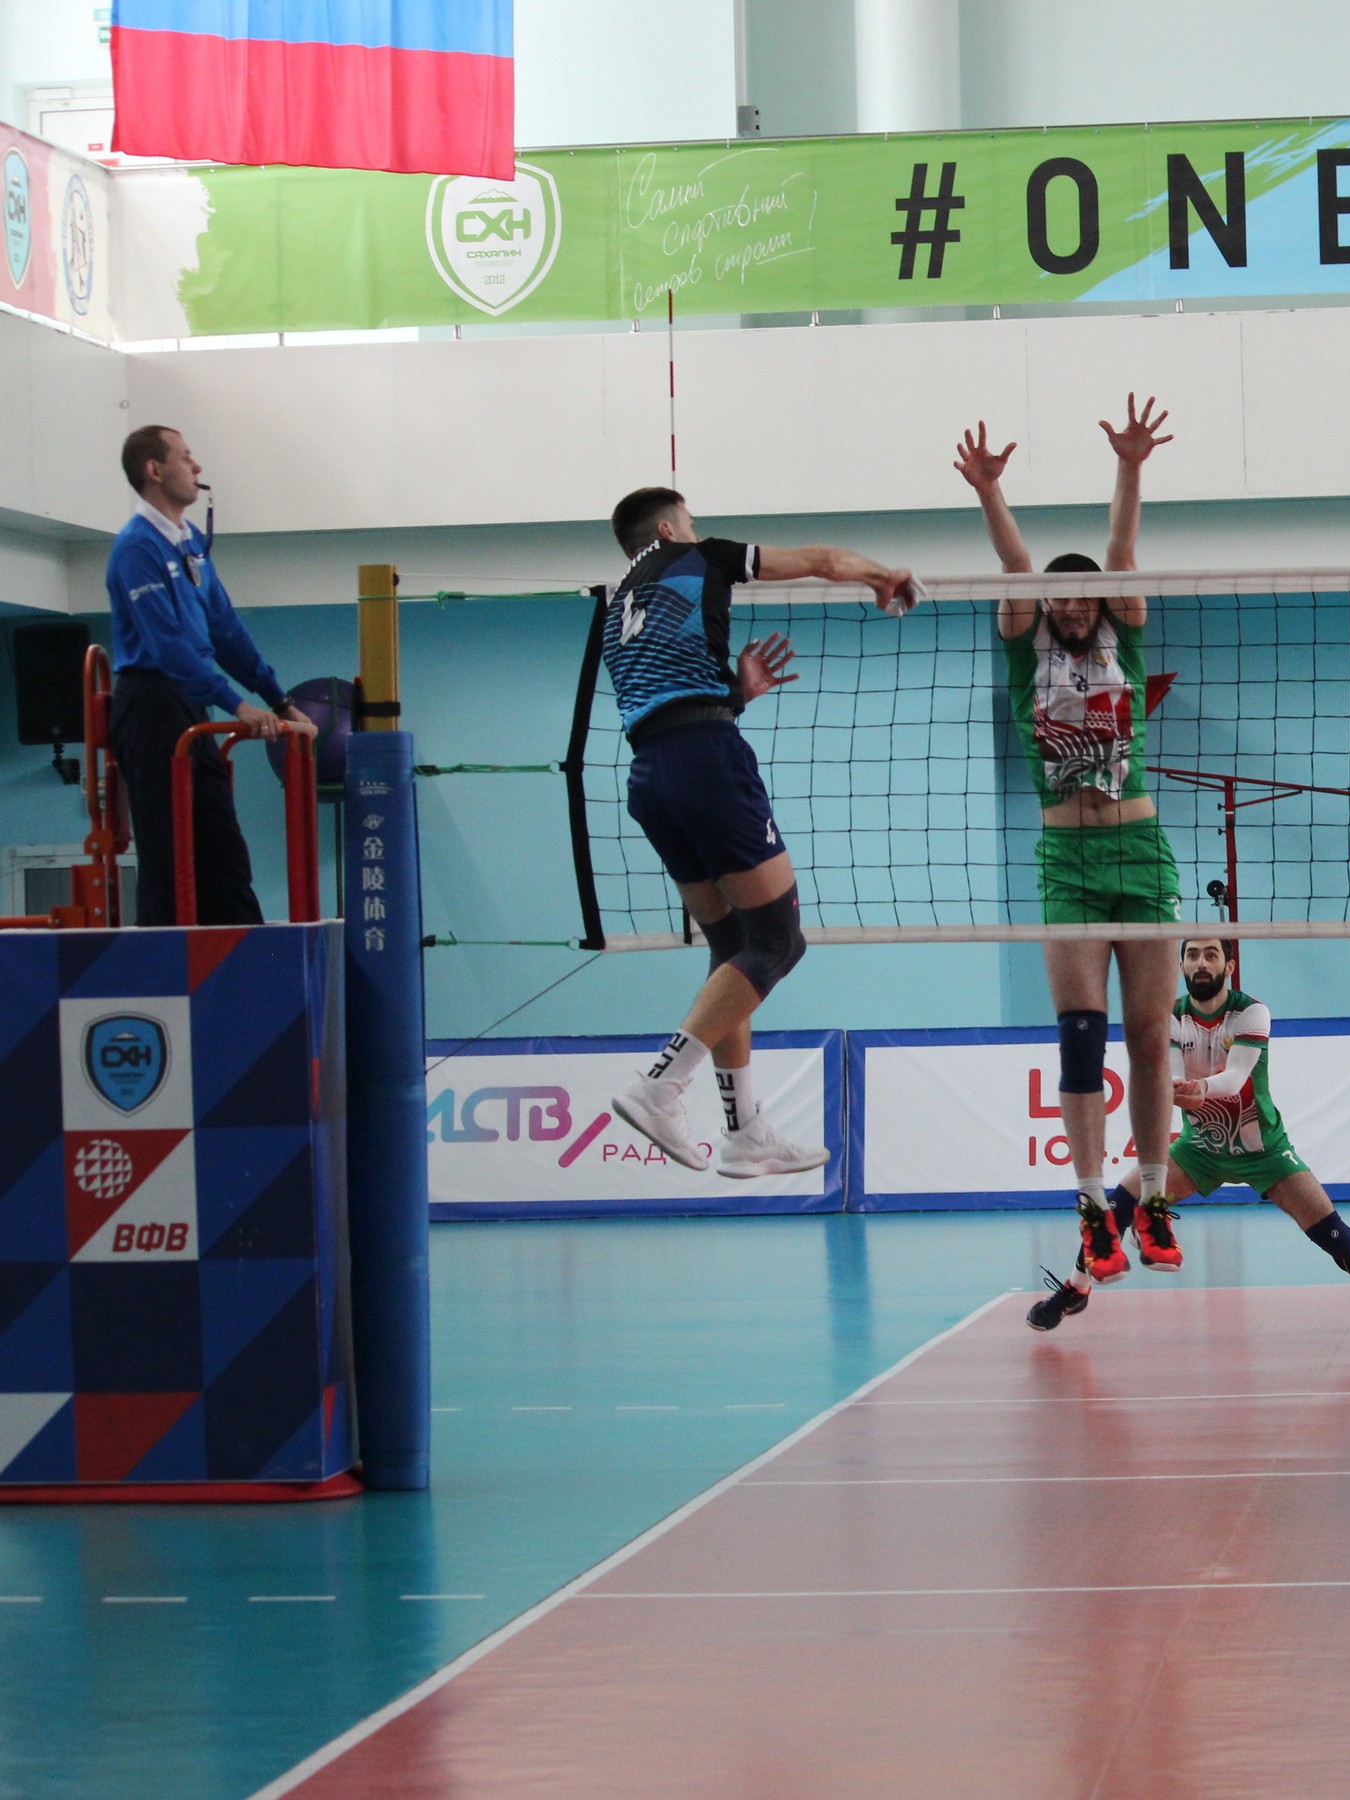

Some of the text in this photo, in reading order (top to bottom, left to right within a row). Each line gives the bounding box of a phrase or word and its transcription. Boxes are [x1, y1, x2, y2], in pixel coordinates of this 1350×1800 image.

[483, 275, 506, 285] 2012
[619, 589, 647, 646] 4
[362, 836, 386, 952] 金陵体育
[112, 1222, 189, 1252] ВФВ
